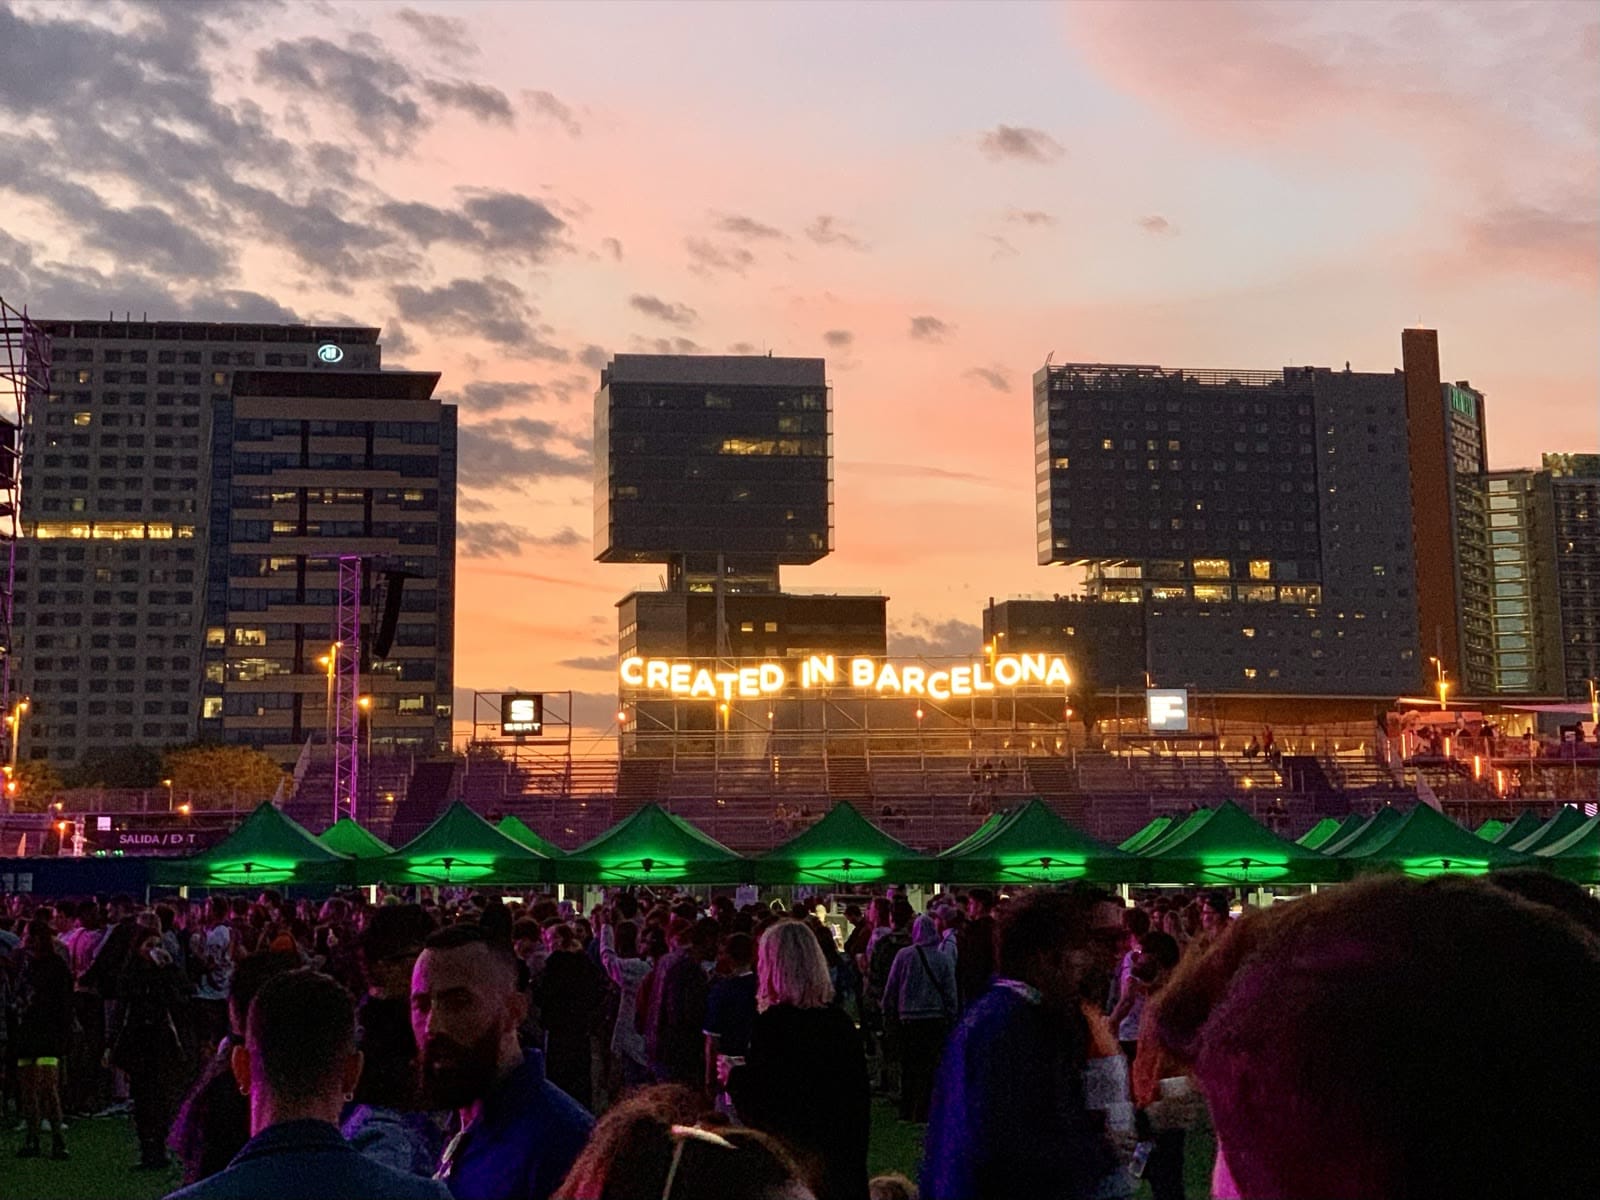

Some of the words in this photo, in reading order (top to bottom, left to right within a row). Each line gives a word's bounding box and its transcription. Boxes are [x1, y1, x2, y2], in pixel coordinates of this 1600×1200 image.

[620, 656, 785, 699] CREATED
[802, 655, 835, 688] IN
[851, 653, 1071, 699] BARCELONA
[119, 833, 160, 844] SALIDA
[170, 833, 196, 844] EXT
